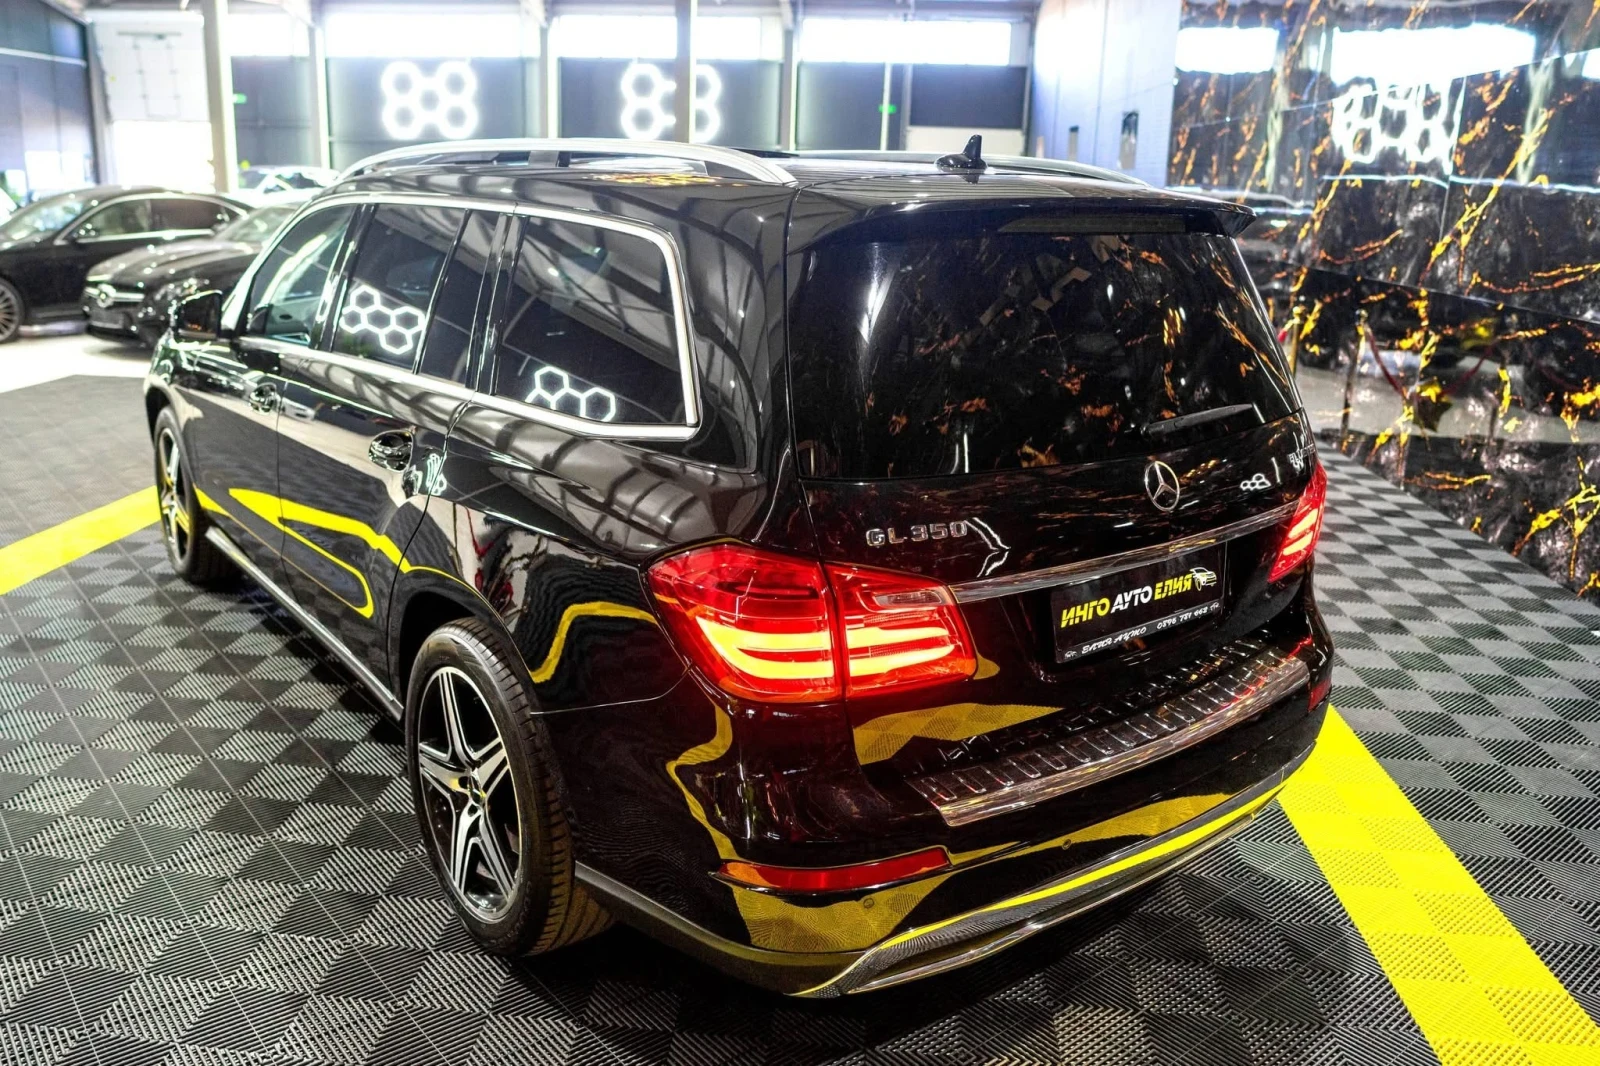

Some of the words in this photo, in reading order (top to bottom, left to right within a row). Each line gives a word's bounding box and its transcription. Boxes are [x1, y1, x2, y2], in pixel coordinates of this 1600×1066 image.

[865, 527, 907, 547] GL
[910, 520, 967, 542] 350
[1060, 597, 1111, 628] ИНГО
[1110, 585, 1153, 614] АУТО
[1154, 573, 1193, 600] ЕЛИЯ
